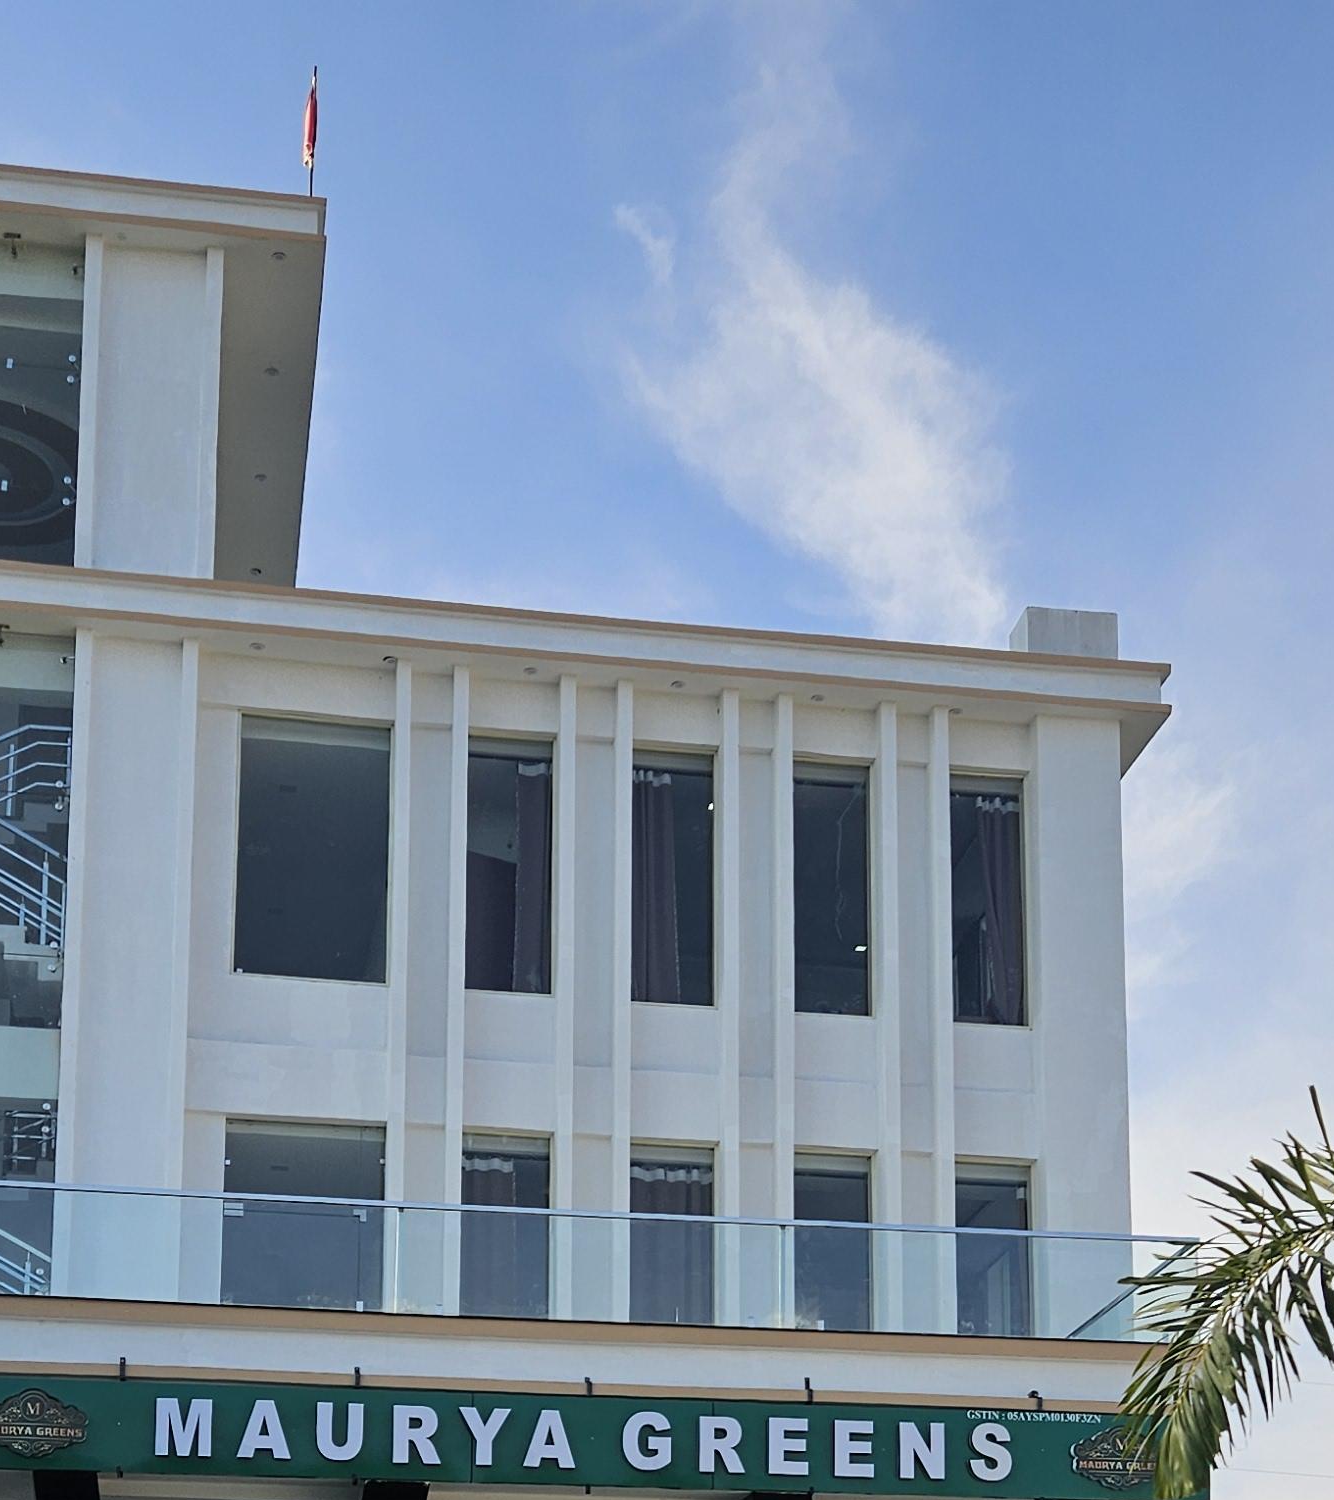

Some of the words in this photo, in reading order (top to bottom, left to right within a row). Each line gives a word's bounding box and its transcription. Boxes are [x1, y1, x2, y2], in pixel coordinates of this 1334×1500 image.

[26, 1401, 41, 1416] M
[966, 1409, 1000, 1421] GSTIN
[36, 1426, 83, 1438] GREENS
[154, 1397, 576, 1469] MAURYA
[621, 1410, 1014, 1483] GREENS
